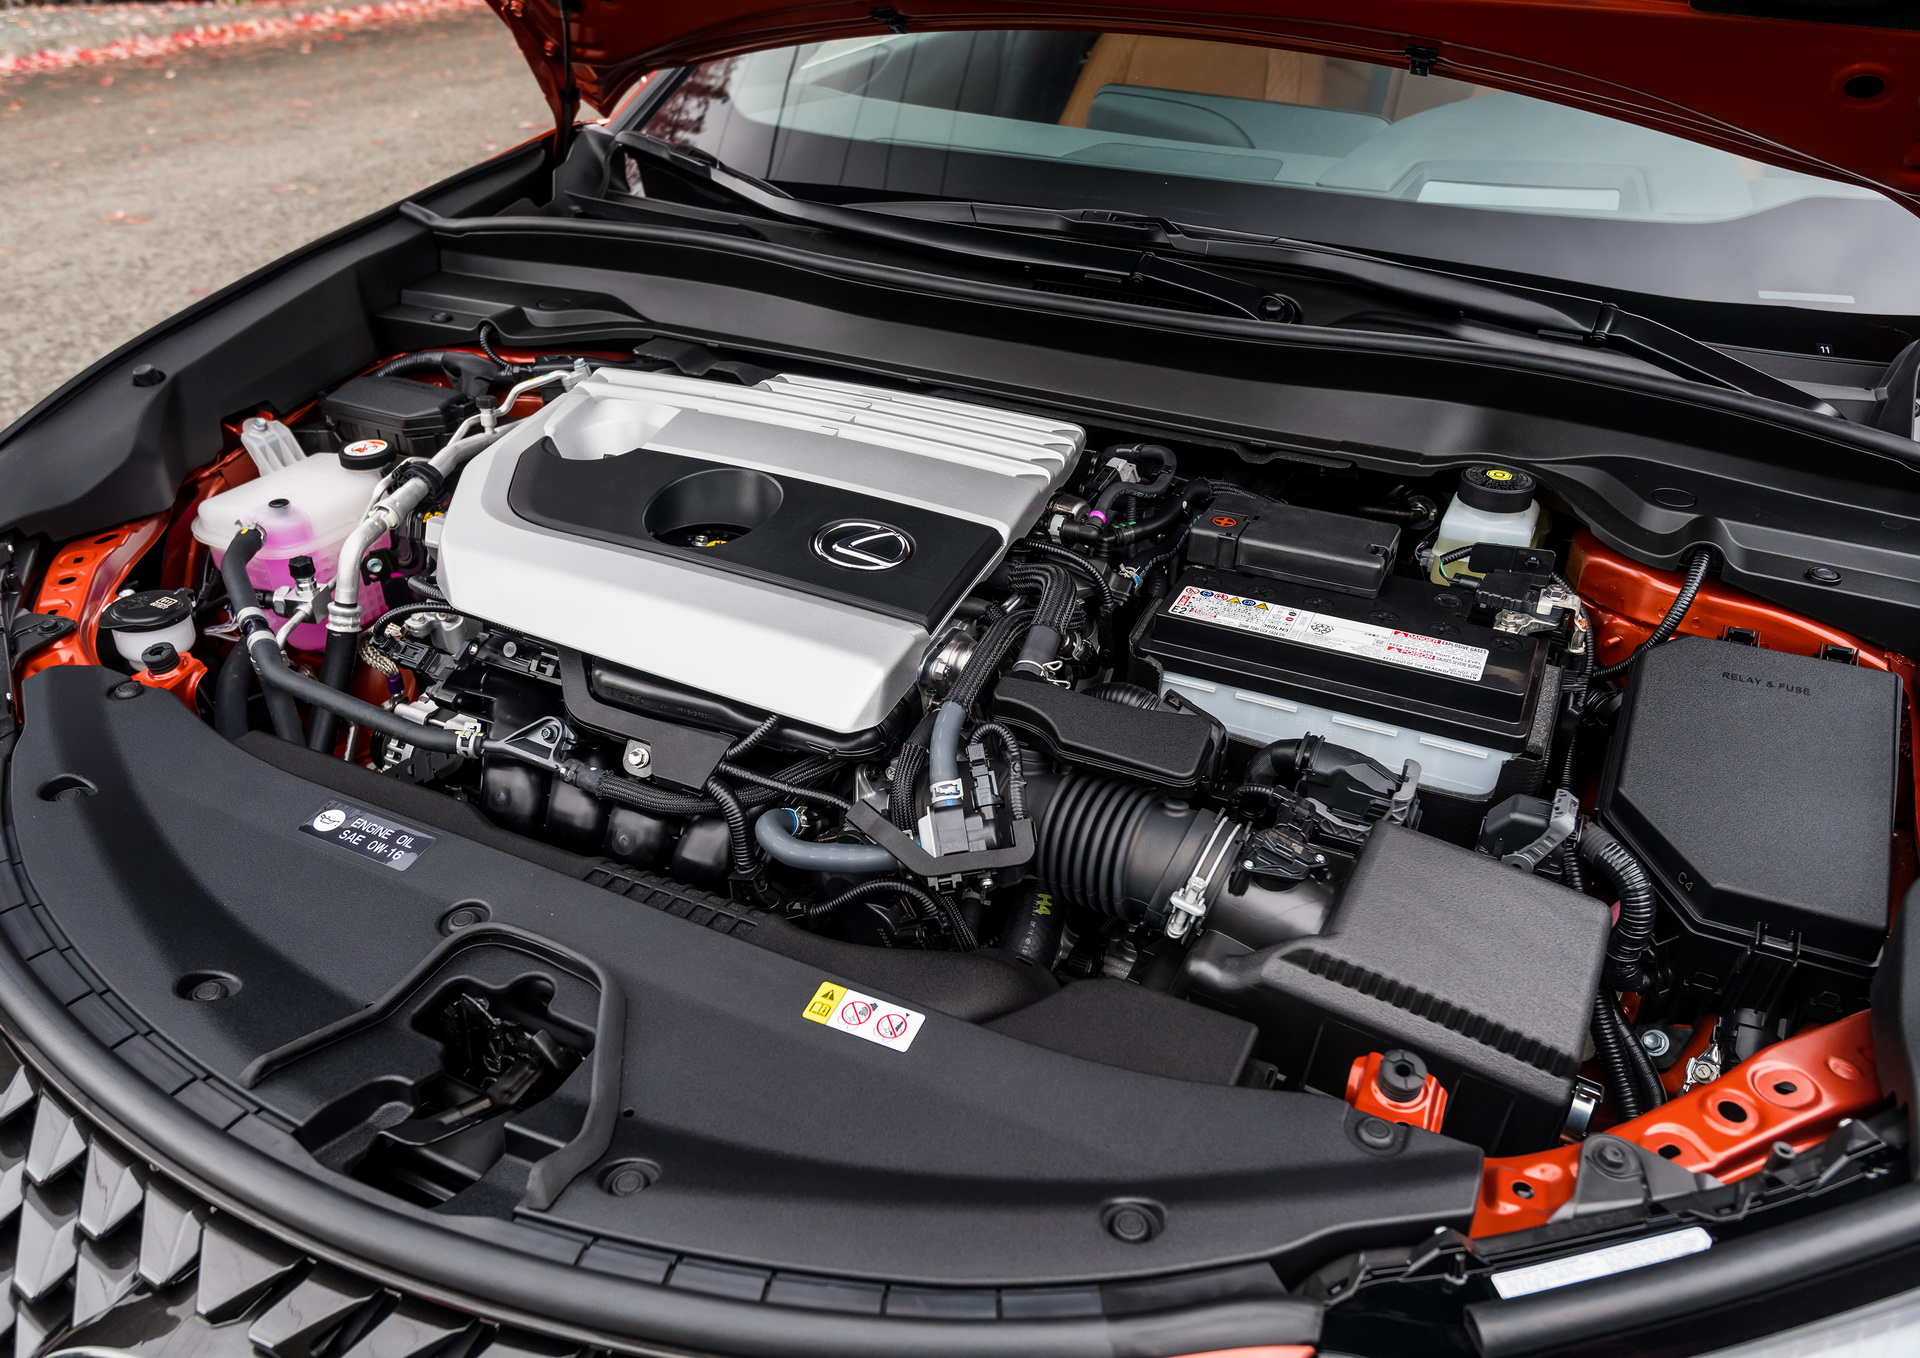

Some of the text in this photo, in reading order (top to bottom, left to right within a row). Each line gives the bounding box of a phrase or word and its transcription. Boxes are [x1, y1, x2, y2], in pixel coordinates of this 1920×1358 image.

[1819, 345, 1830, 354] 11
[1171, 605, 1187, 615] E2
[1402, 649, 1432, 660] POISON
[1408, 633, 1487, 655] DANGER EXPLOSIVE GASES
[1464, 658, 1482, 666] LEVEL
[1722, 671, 1811, 696] RELAY & FUSE
[1271, 711, 1356, 739] UPPER LEVEL
[350, 817, 414, 849] ENGINE OIL
[338, 829, 405, 860] SAE 0W-16
[1678, 871, 1694, 891] C4
